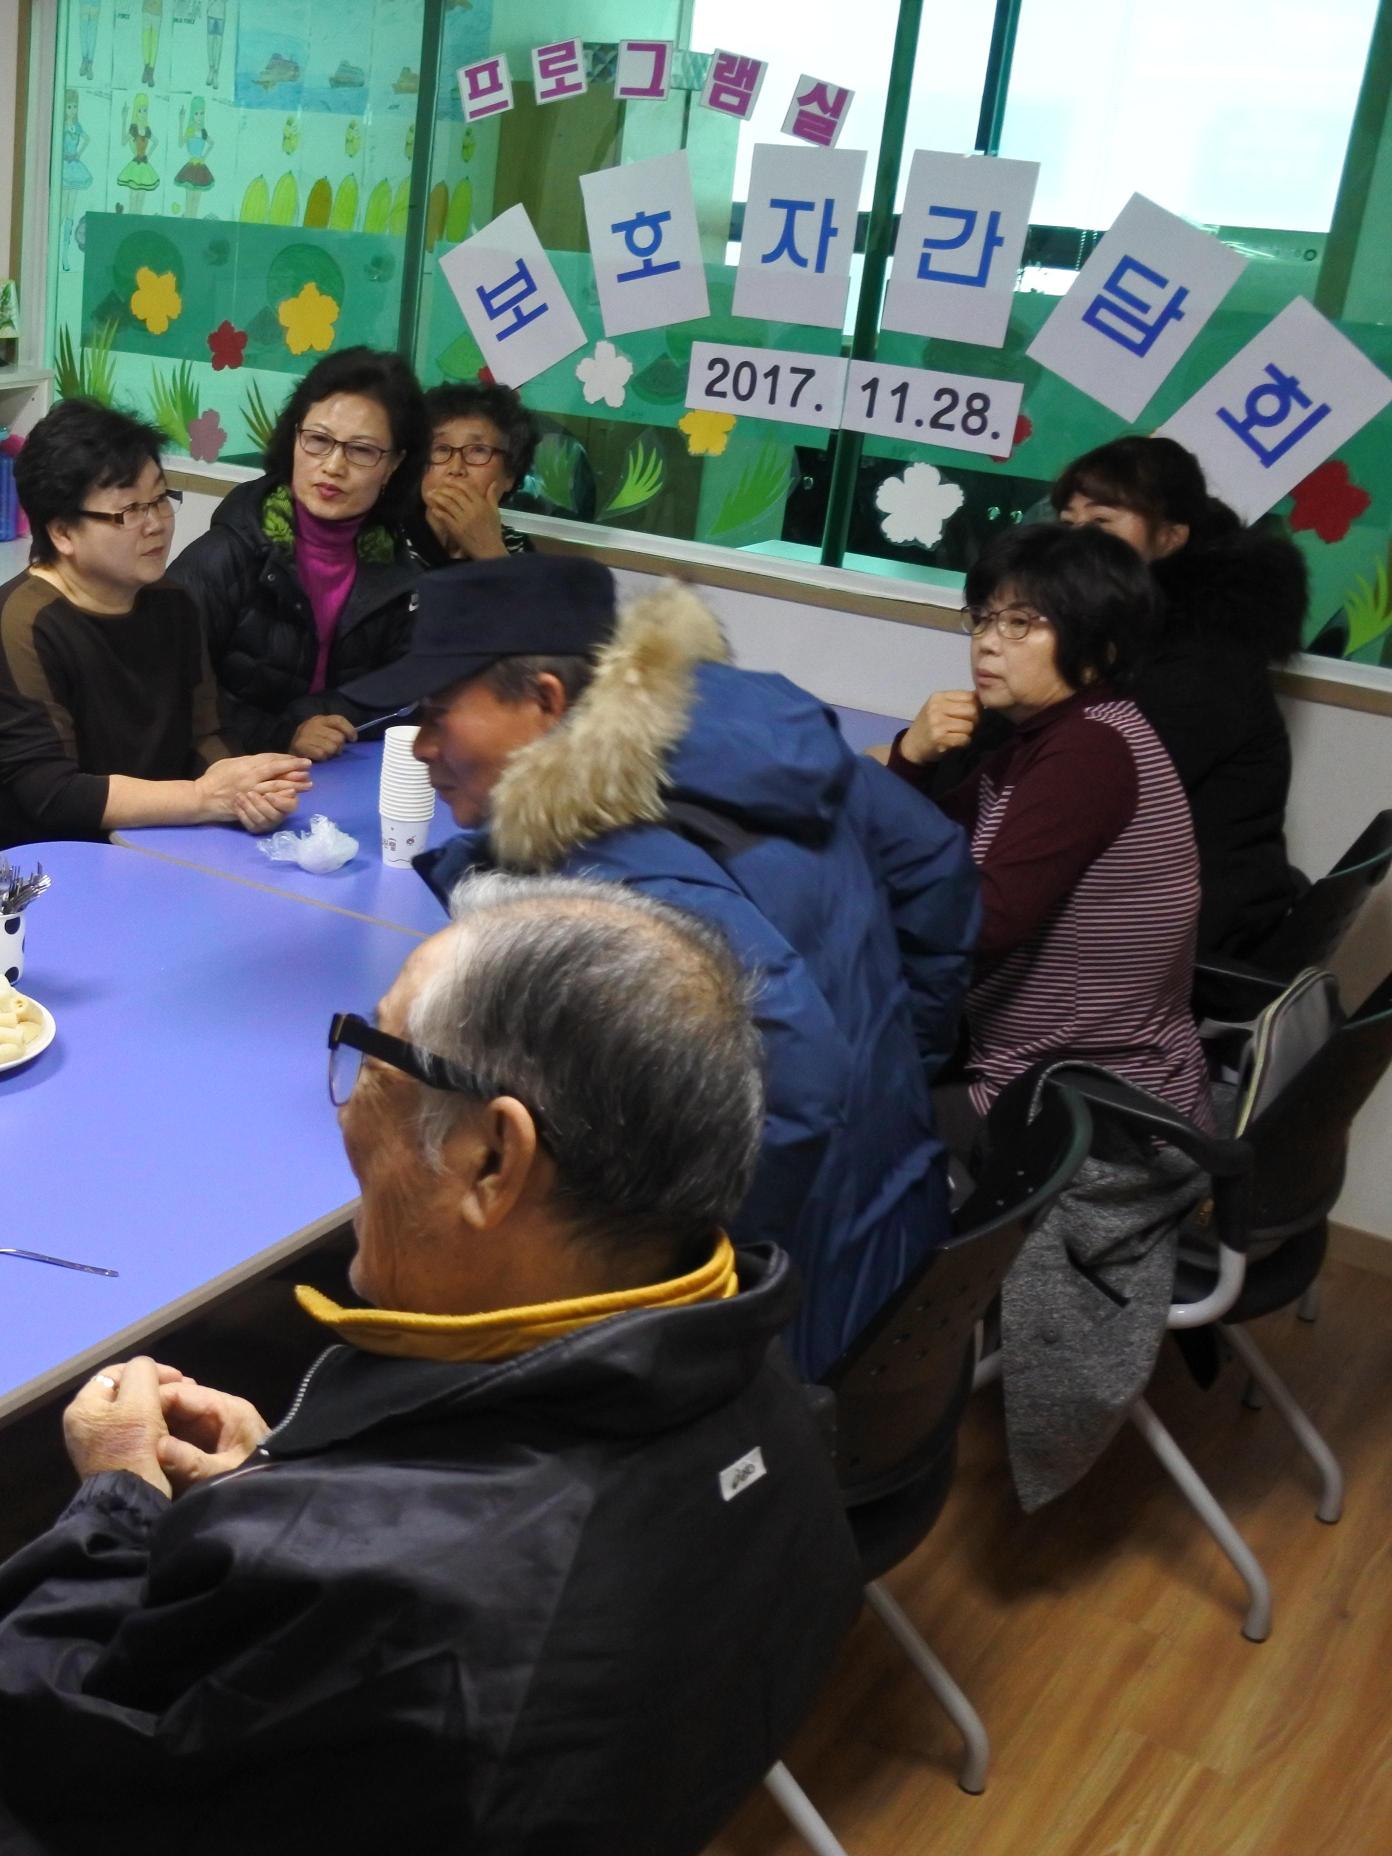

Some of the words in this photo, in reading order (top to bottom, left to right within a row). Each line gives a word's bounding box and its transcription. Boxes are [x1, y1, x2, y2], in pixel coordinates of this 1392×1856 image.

[464, 41, 851, 147] 프로그램실
[704, 357, 823, 412] 2017.
[860, 377, 1001, 440] 11.28.
